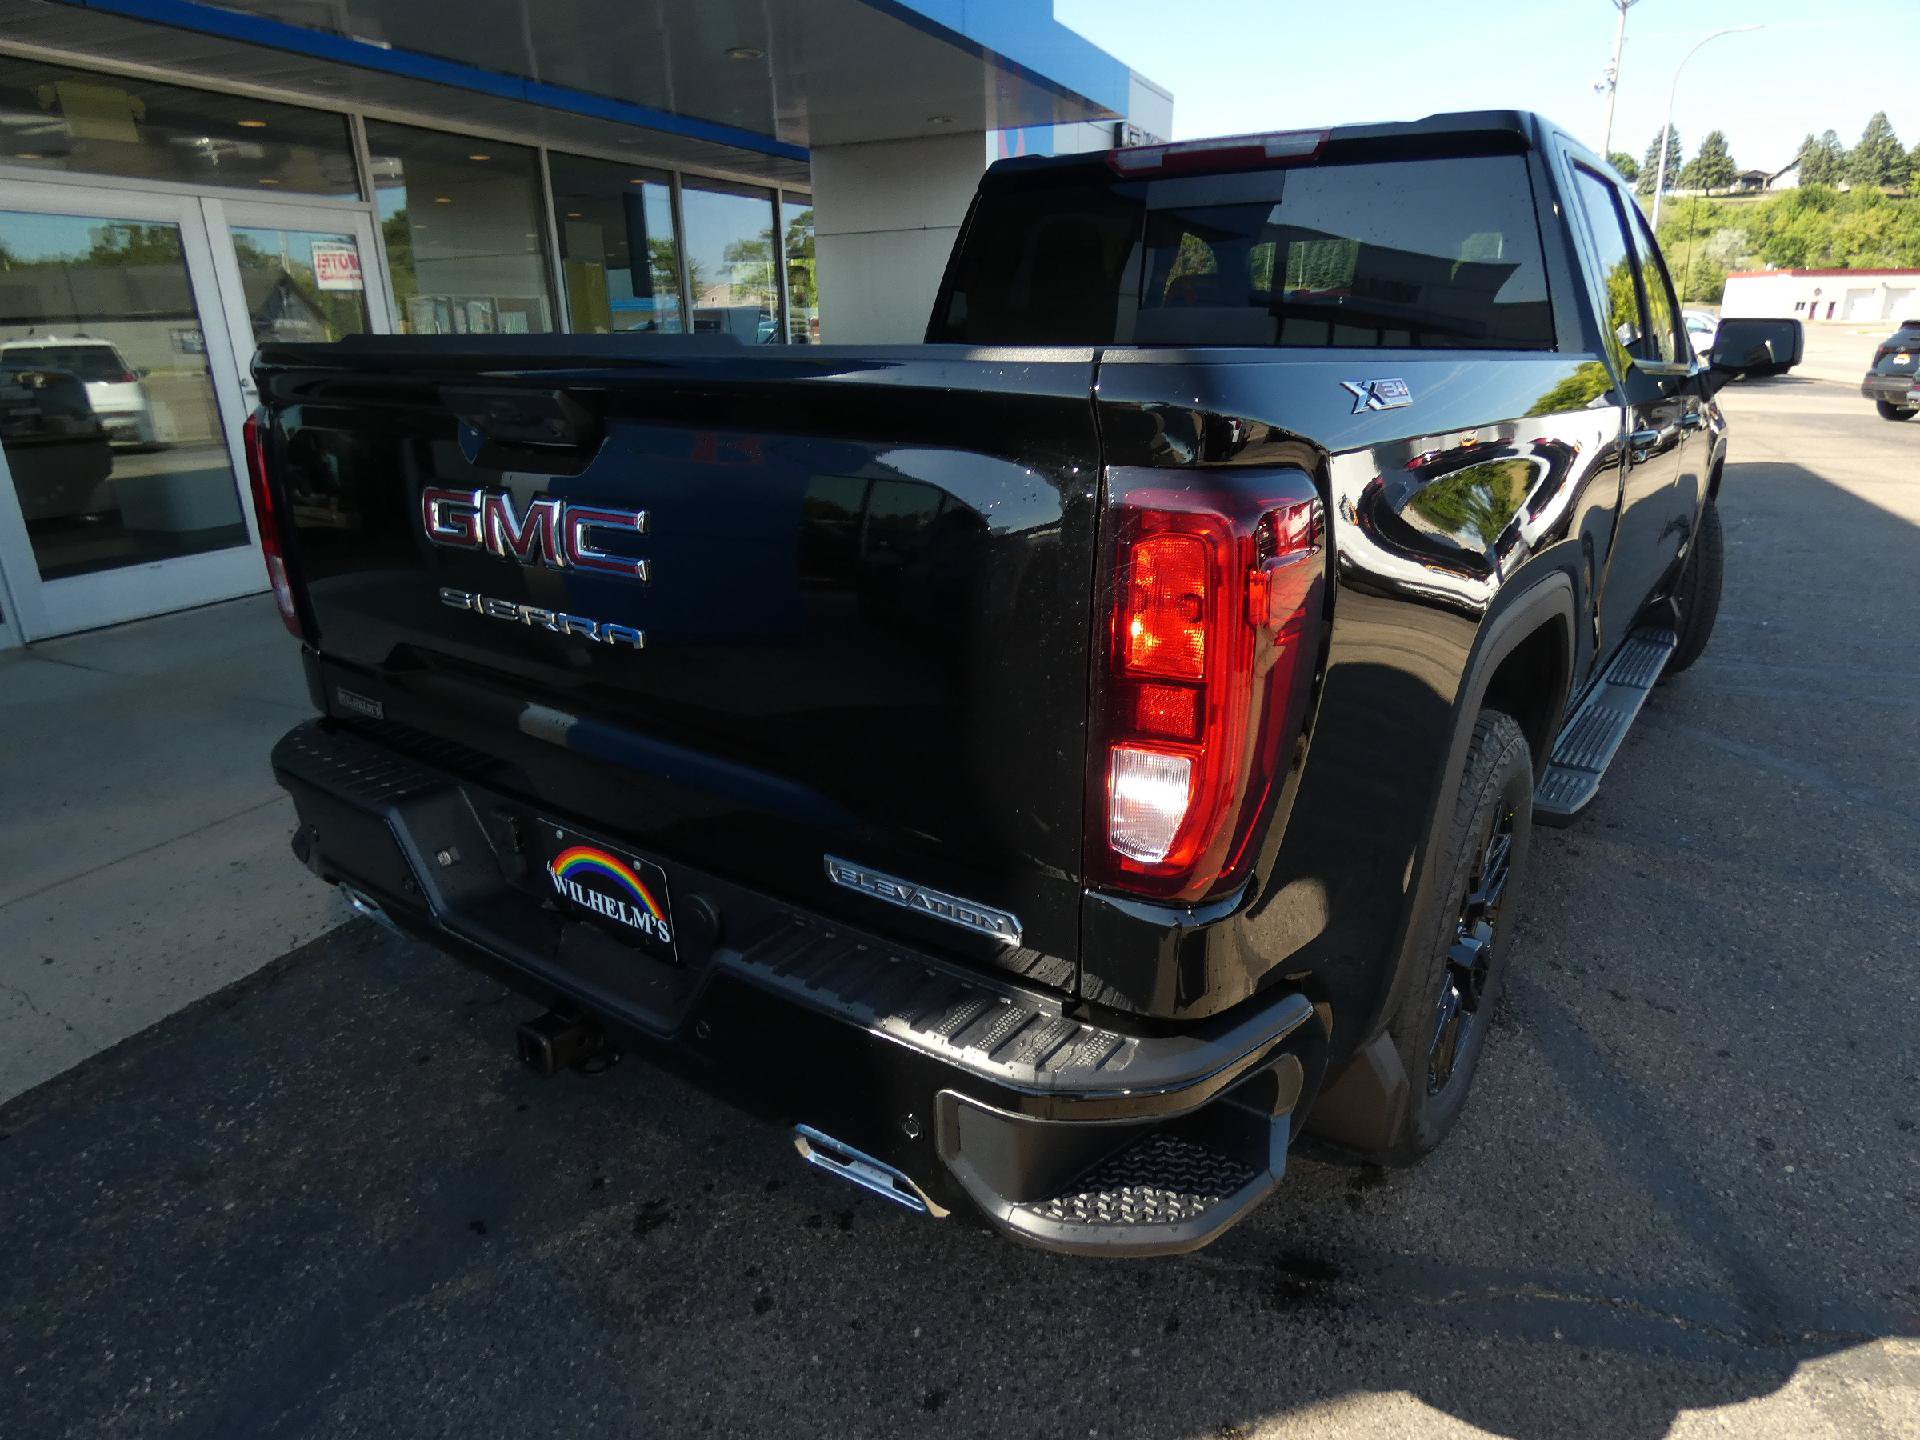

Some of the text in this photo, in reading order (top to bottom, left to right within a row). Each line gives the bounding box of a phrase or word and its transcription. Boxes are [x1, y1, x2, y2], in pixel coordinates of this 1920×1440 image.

[422, 486, 649, 582] GMC
[439, 587, 646, 649] SIERRA
[840, 866, 1006, 934] ELEVATION
